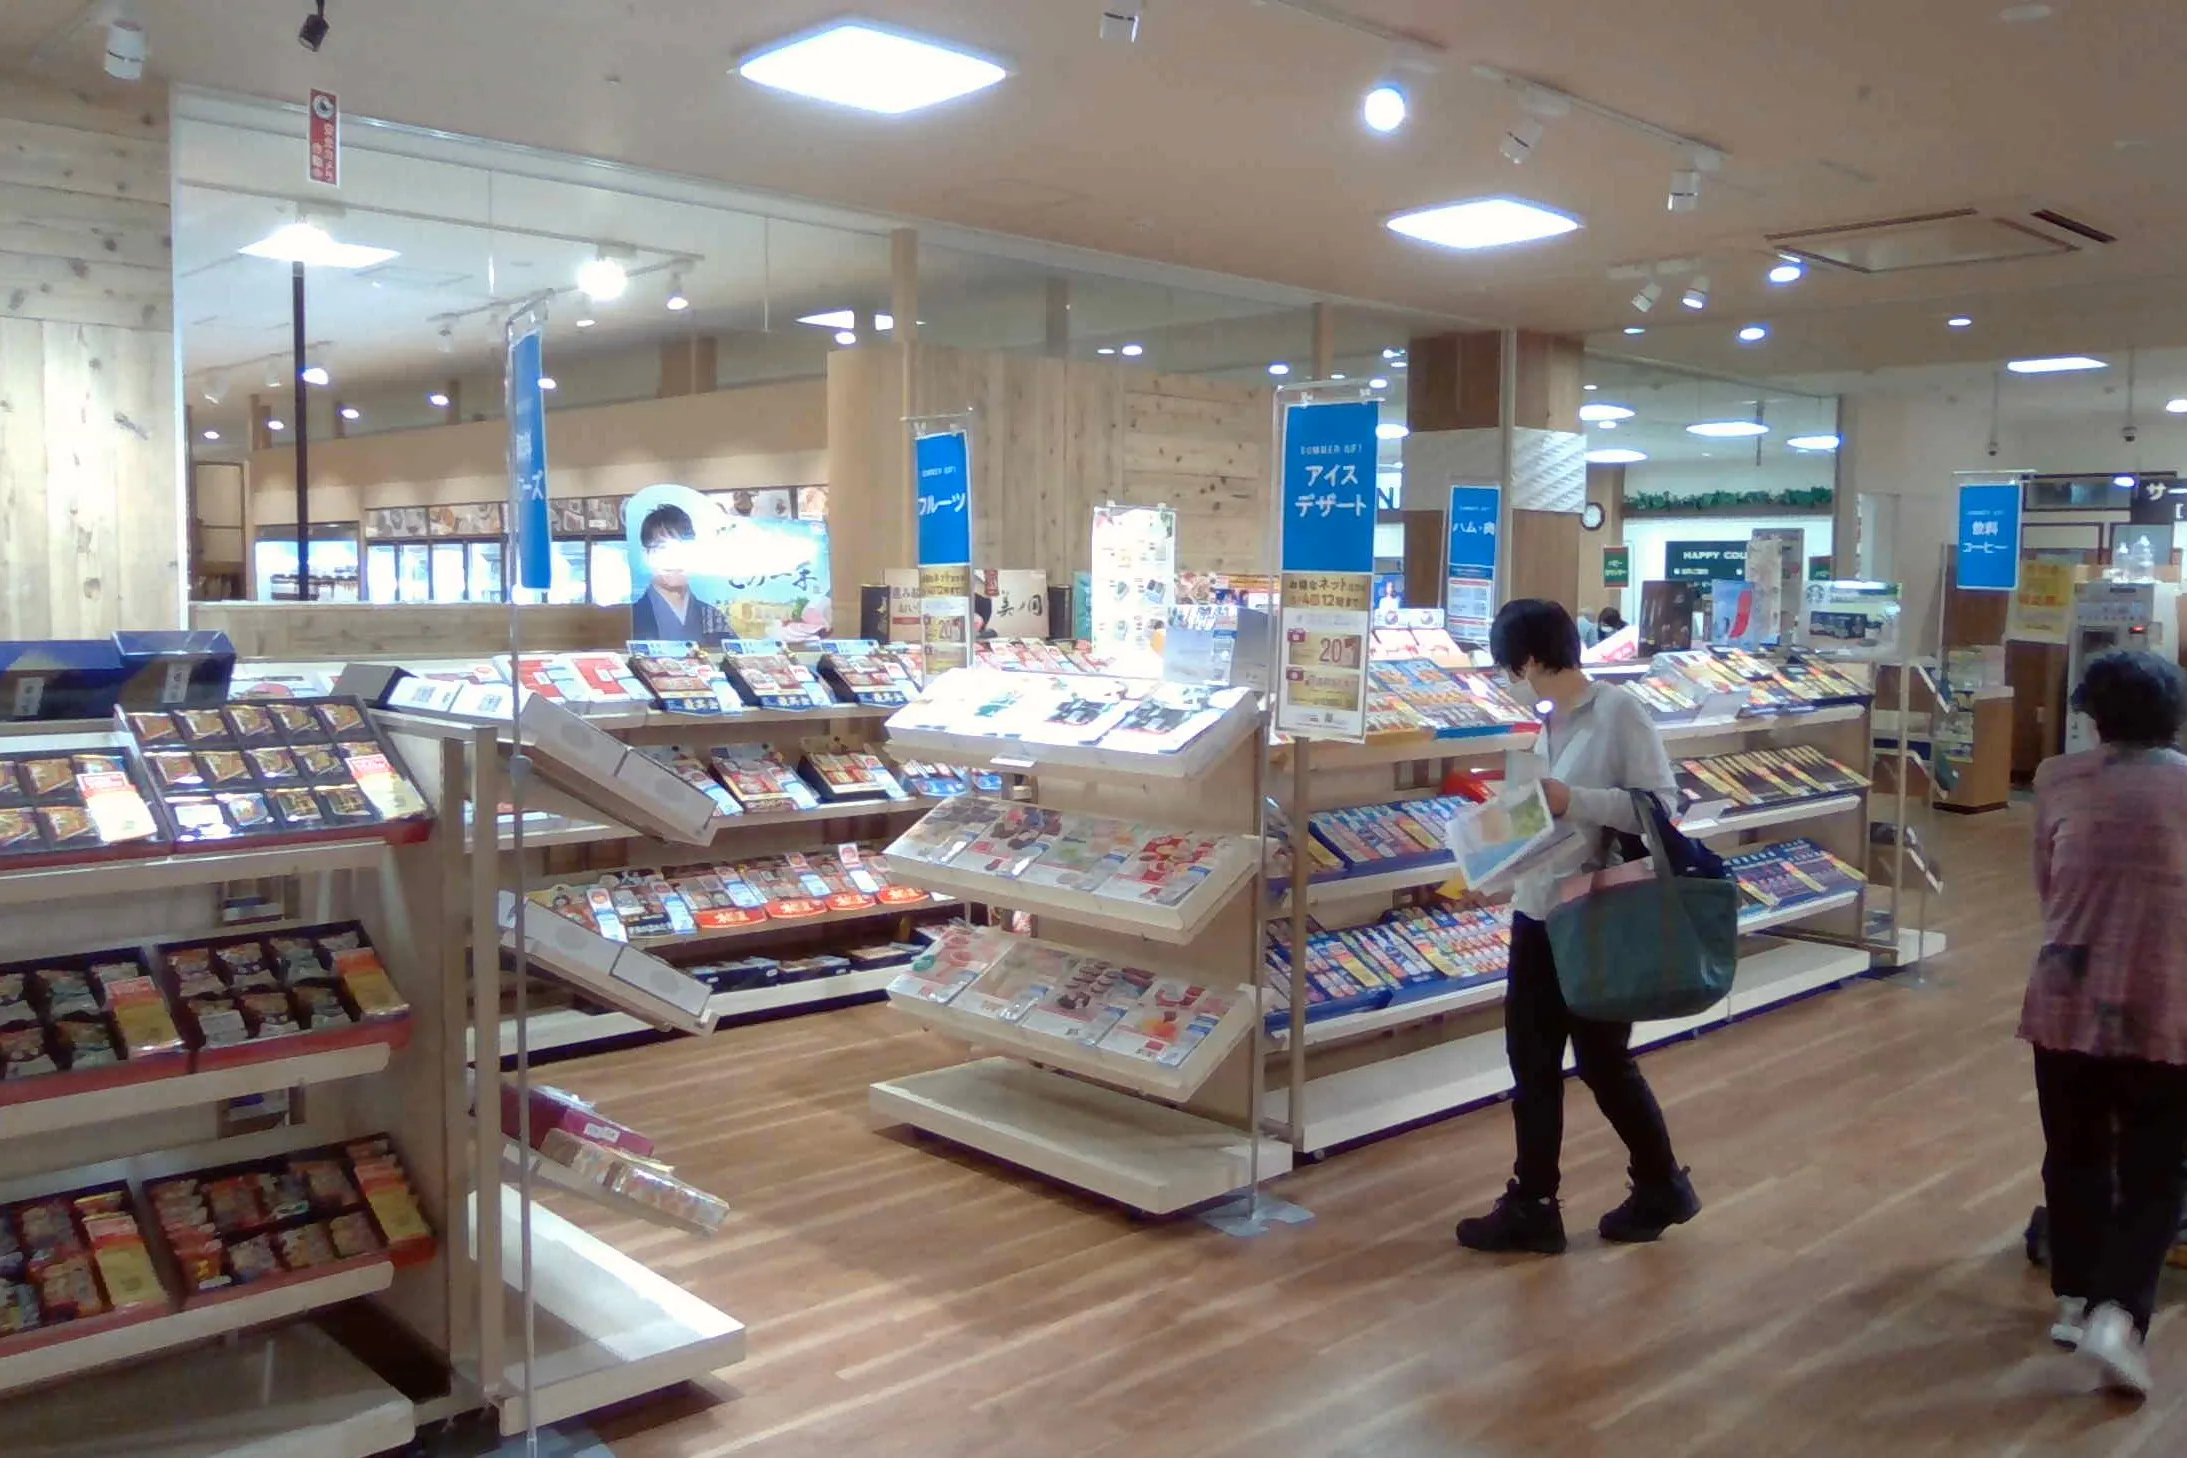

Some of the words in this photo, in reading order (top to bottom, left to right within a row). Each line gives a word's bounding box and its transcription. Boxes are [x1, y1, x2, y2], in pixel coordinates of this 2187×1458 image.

[1305, 464, 1359, 487] アイス
[918, 493, 966, 516] フルーツ
[1294, 493, 1368, 517] デザート
[1683, 551, 1719, 560] HAPPY
[1962, 542, 2009, 554] コーヒー
